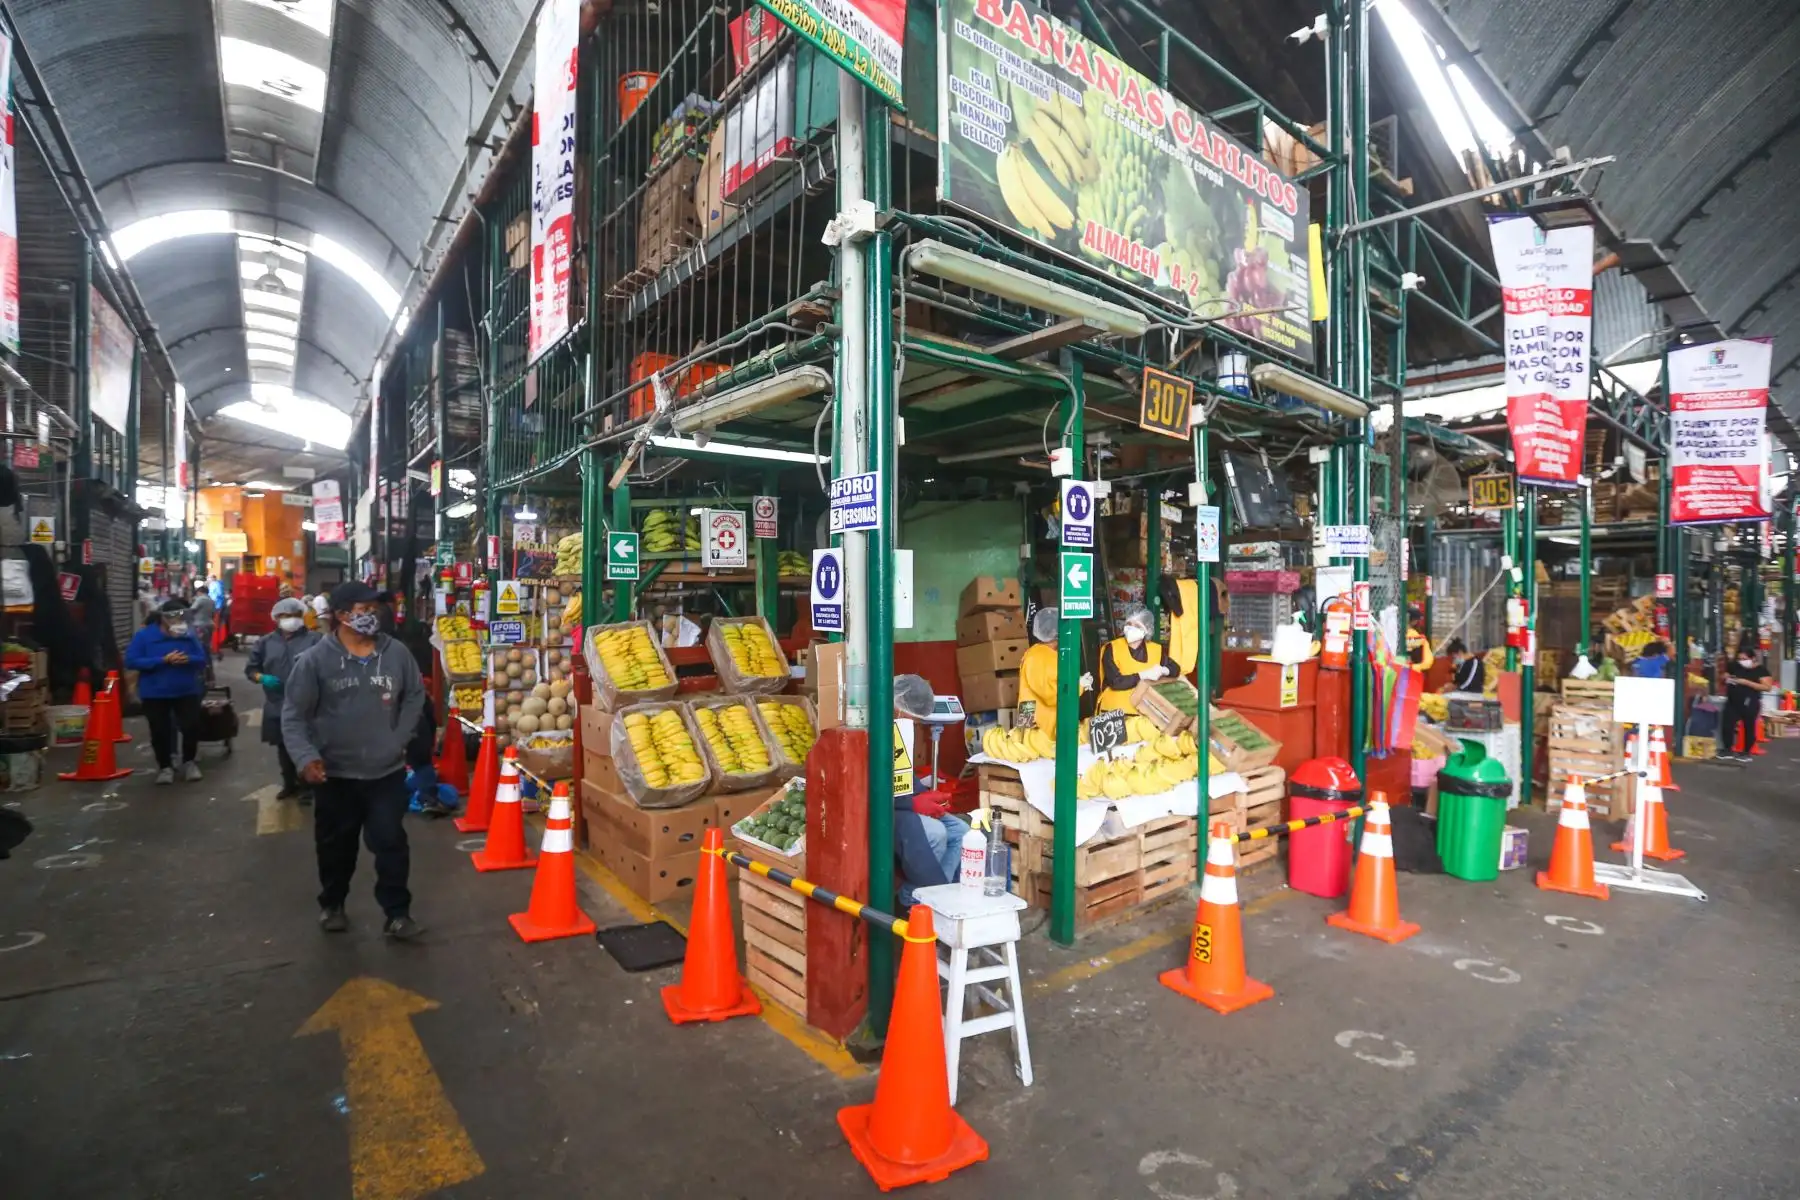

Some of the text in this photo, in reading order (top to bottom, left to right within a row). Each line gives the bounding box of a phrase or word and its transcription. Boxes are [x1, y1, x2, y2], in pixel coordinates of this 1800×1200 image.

[820, 19, 847, 59] 1404
[854, 45, 868, 75] La
[878, 33, 899, 76] Victoria
[956, 22, 1082, 105] LES OFRECE UNA GRAN VARIEDAD
[971, 69, 992, 91] ISLA
[999, 65, 1050, 102] EN PLATANOS
[951, 77, 1011, 120] BISCOCHITO
[974, 0, 1298, 216] BANANAS CARLITOS
[959, 100, 1005, 136] MANZANO
[1103, 104, 1117, 120] DE
[1119, 115, 1153, 143] CARLOS
[962, 121, 1003, 153] BELLACO
[1083, 219, 1161, 280] ALMACEN
[1188, 271, 1200, 297] 2
[1552, 331, 1584, 343] POR
[1517, 374, 1528, 385] Y
[1147, 378, 1188, 429] 307
[1727, 428, 1757, 438] CON
[1731, 417, 1759, 427] POR
[1675, 439, 1758, 449] MASCARILLAS
[831, 475, 875, 499] AFORO
[1474, 478, 1509, 504] 305
[832, 509, 841, 526] 3
[1326, 527, 1368, 538] AFORO
[611, 566, 636, 575] SALIDA
[1064, 601, 1091, 611] ENTRADA
[493, 623, 520, 631] AFORO
[894, 783, 910, 793] ECCION
[897, 775, 903, 783] DE
